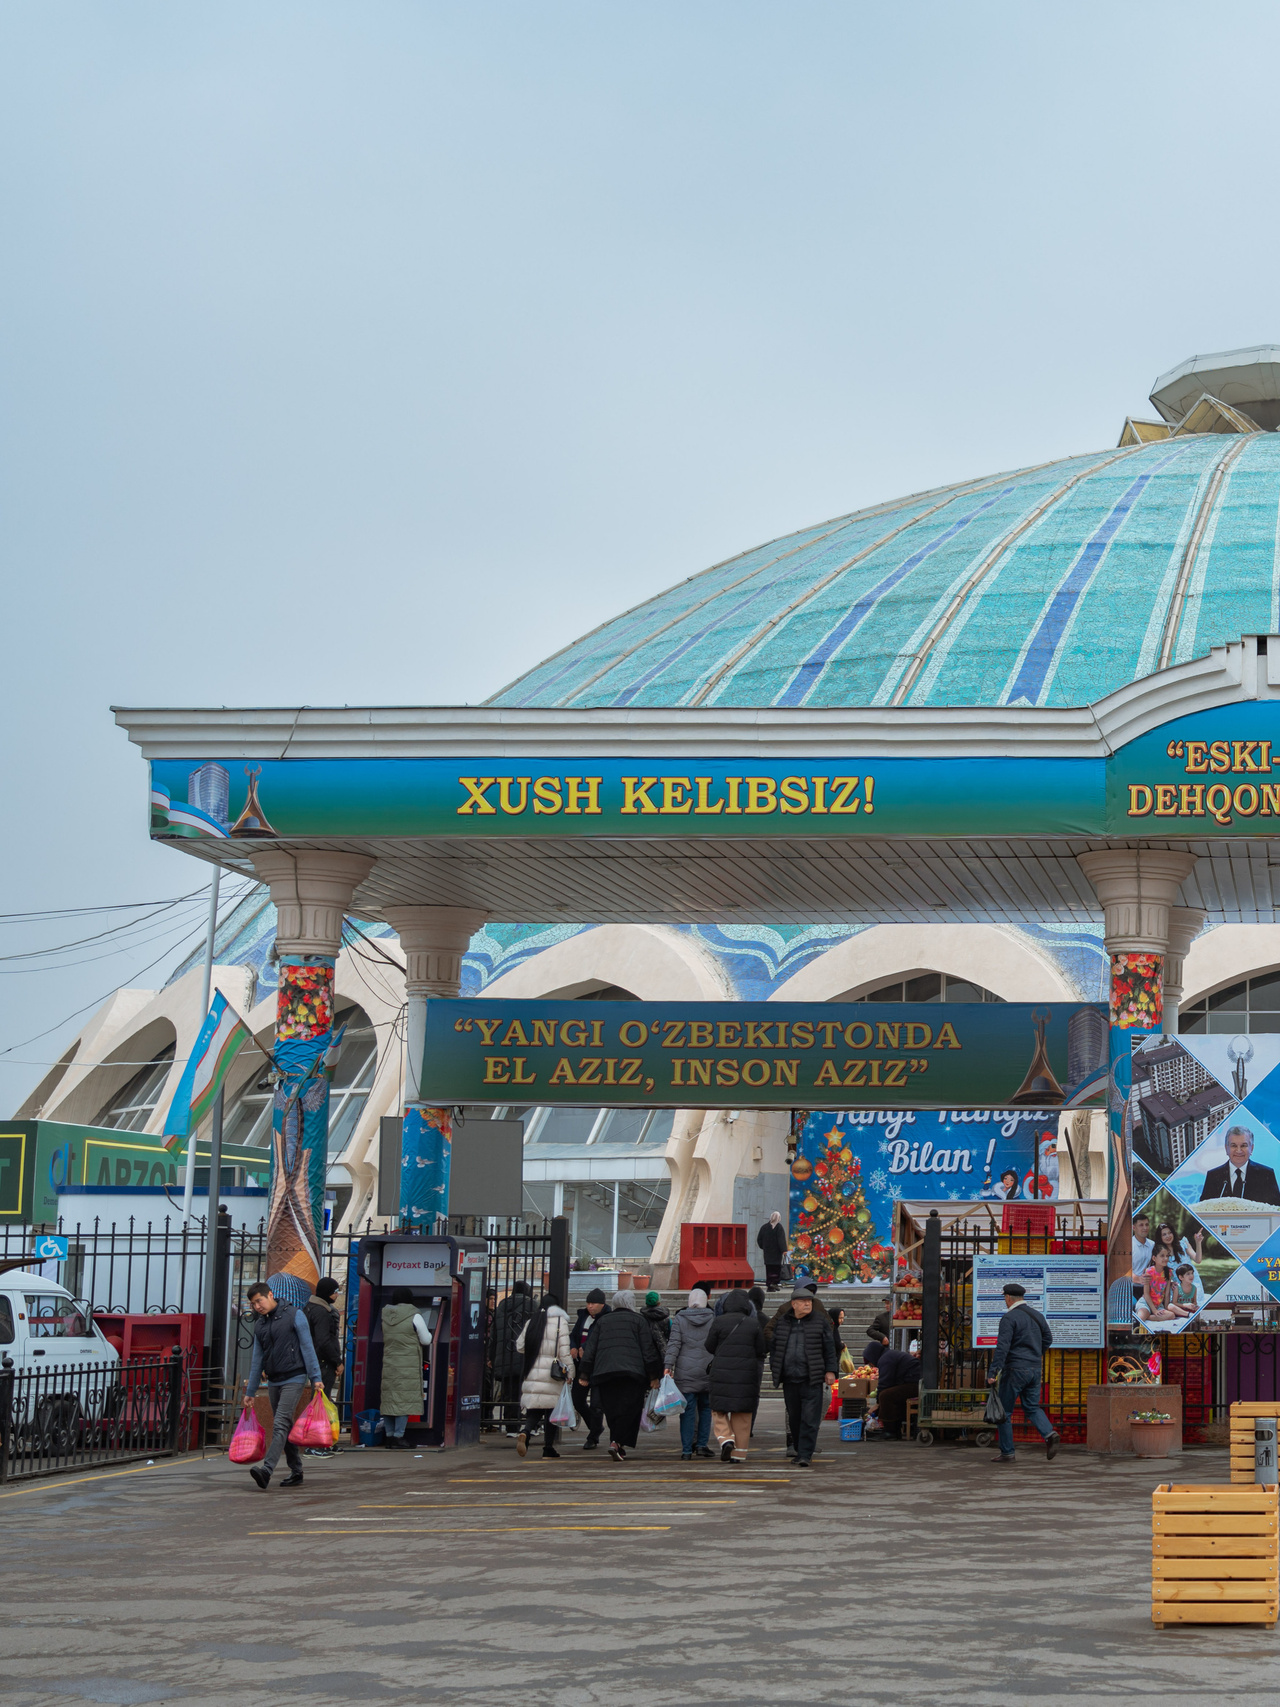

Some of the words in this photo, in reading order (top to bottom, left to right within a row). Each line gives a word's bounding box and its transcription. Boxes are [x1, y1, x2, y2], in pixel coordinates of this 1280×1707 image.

[457, 775, 603, 817] XUSH
[620, 775, 877, 817] KELIBSIZ!
[452, 1018, 605, 1049] “YANGI
[618, 1018, 963, 1050] O‘ZBEKISTONDA
[482, 1057, 537, 1085] EL
[548, 1057, 656, 1092] AZIZ,
[671, 1057, 799, 1087] INSON
[812, 1057, 928, 1087] AZIZ”
[888, 1139, 973, 1174] Bilan
[386, 1261, 421, 1271] Poytaxt
[423, 1261, 447, 1269] Bank
